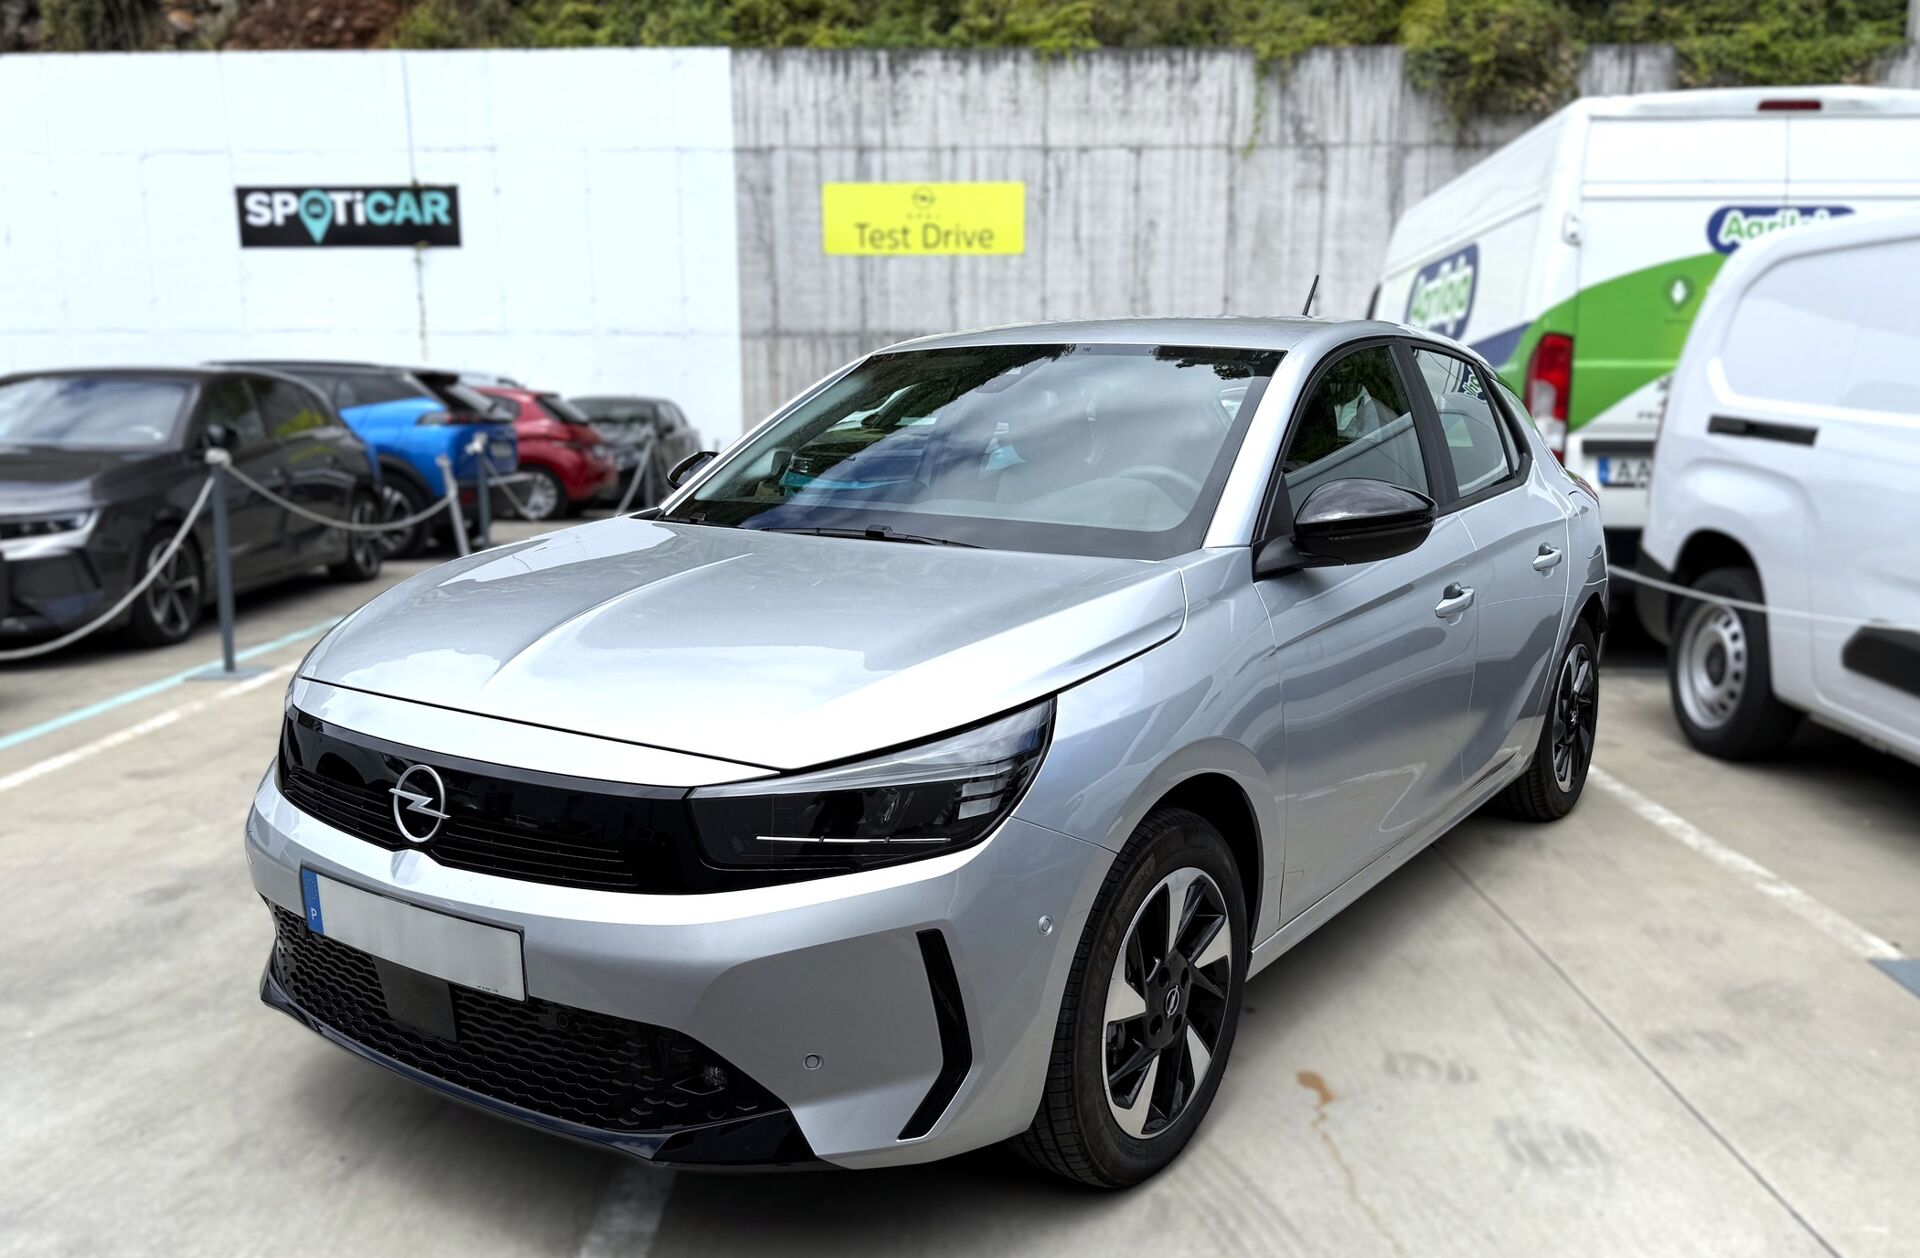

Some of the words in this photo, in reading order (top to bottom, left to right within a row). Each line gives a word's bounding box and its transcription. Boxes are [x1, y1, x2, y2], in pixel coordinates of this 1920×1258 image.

[855, 223, 910, 250] Test
[922, 222, 995, 250] Drive
[310, 907, 317, 920] P
